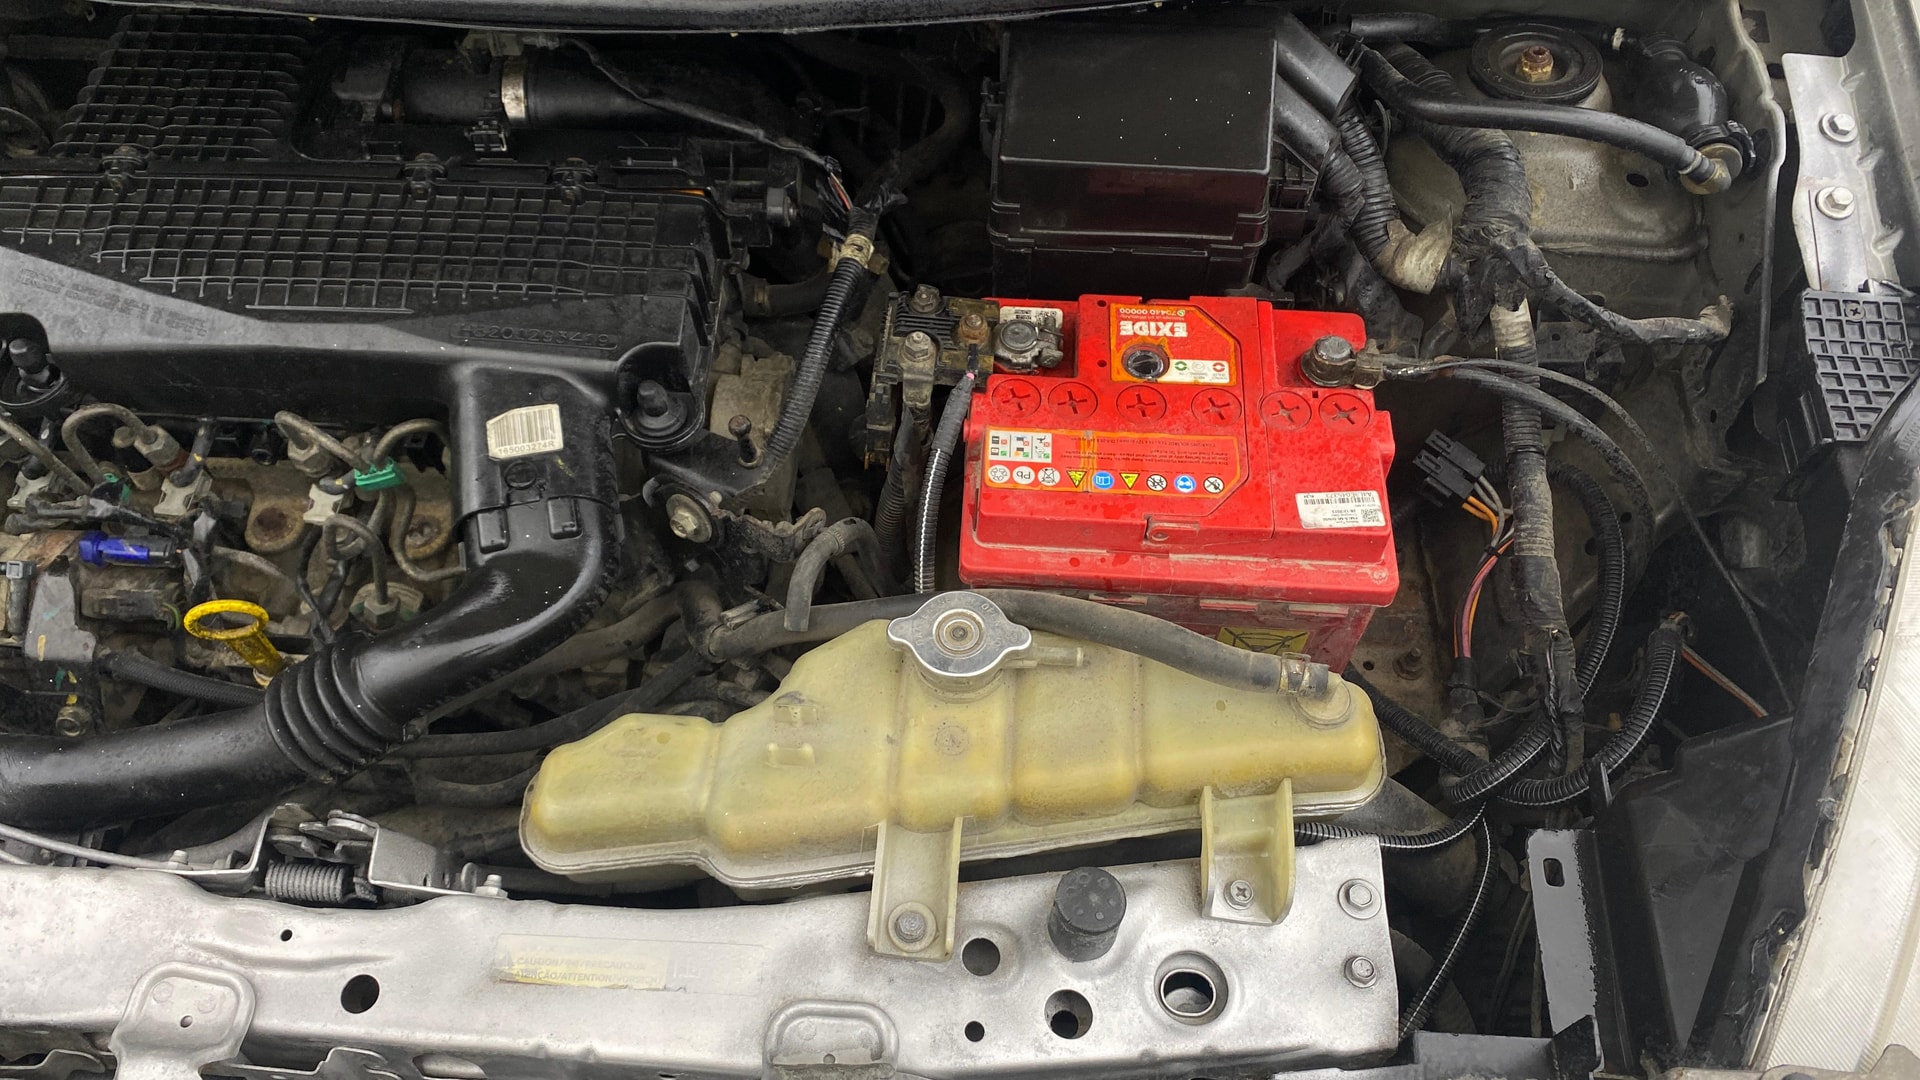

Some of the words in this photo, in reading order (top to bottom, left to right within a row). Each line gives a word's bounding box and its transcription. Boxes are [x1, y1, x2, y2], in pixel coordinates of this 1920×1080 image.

[1119, 320, 1188, 338] EXIDE
[498, 440, 555, 455] 165003274R
[1016, 470, 1031, 480] Pb
